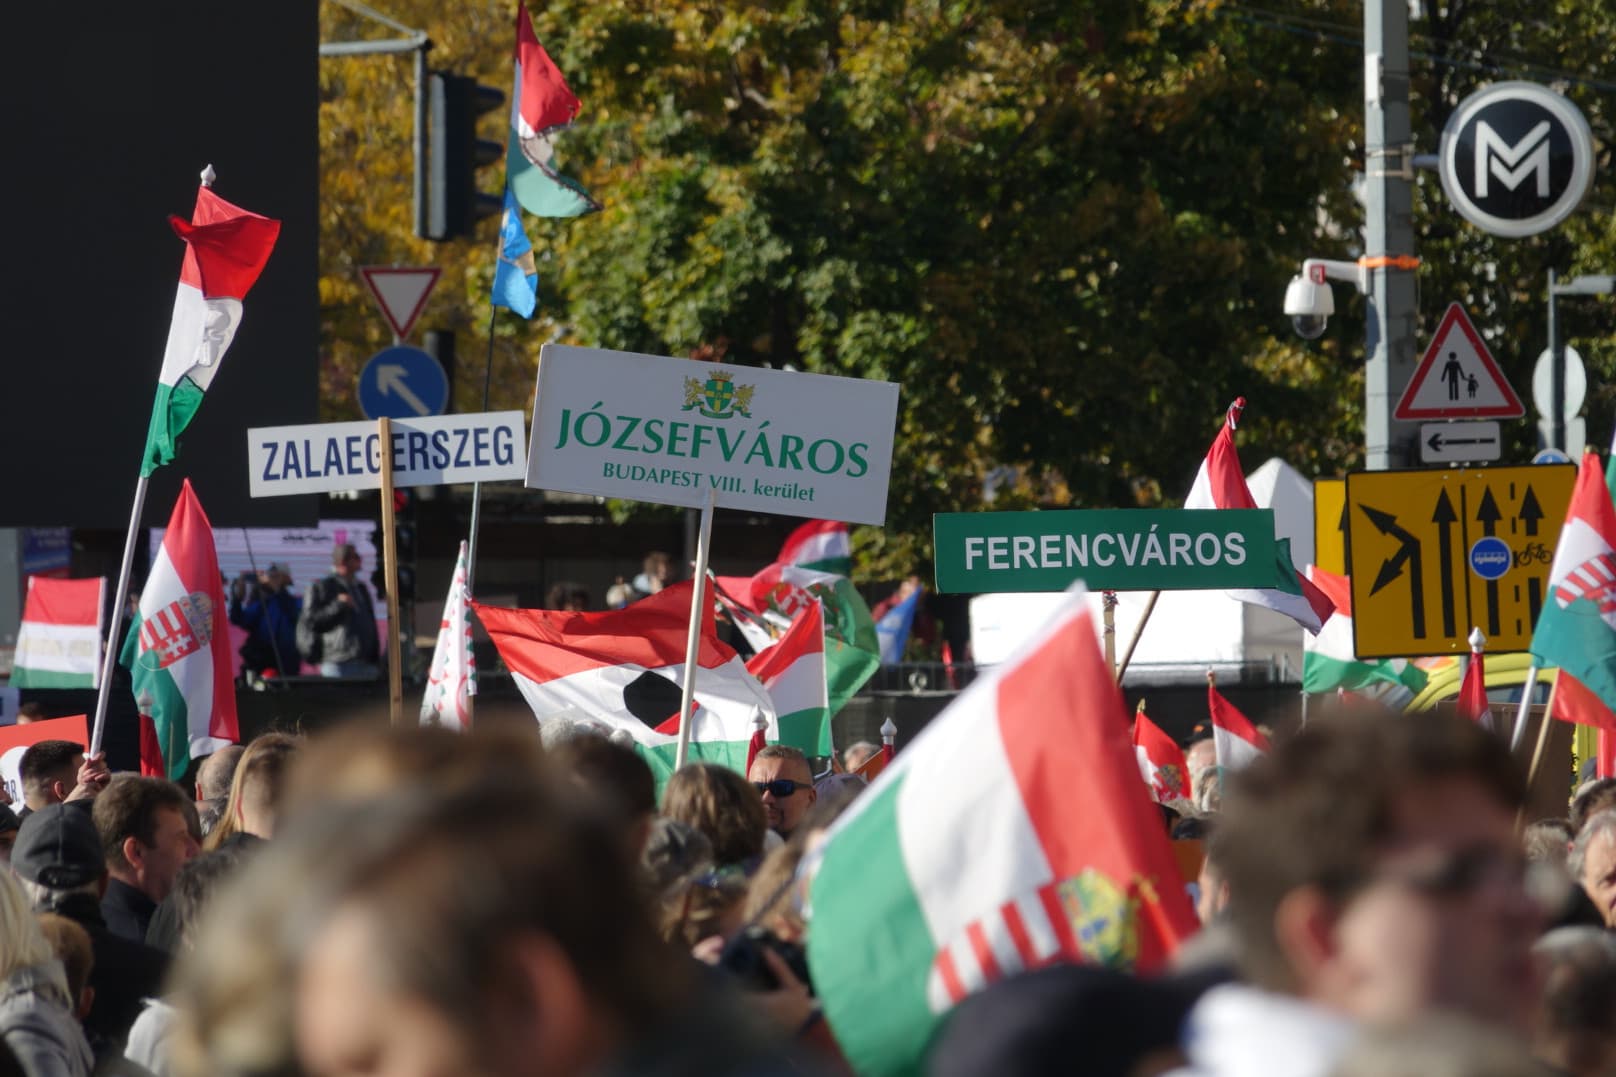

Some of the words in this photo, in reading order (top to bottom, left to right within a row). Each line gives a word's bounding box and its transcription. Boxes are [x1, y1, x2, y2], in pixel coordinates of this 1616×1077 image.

[1475, 120, 1550, 198] M
[262, 425, 514, 481] ZALAEGERSZEG
[554, 401, 869, 477] JÓZSEFVÁROS
[603, 462, 701, 488] BUDAPEST
[709, 475, 746, 494] VIII.
[753, 479, 815, 501] kerület
[965, 524, 1247, 570] FERENCVÁROS
